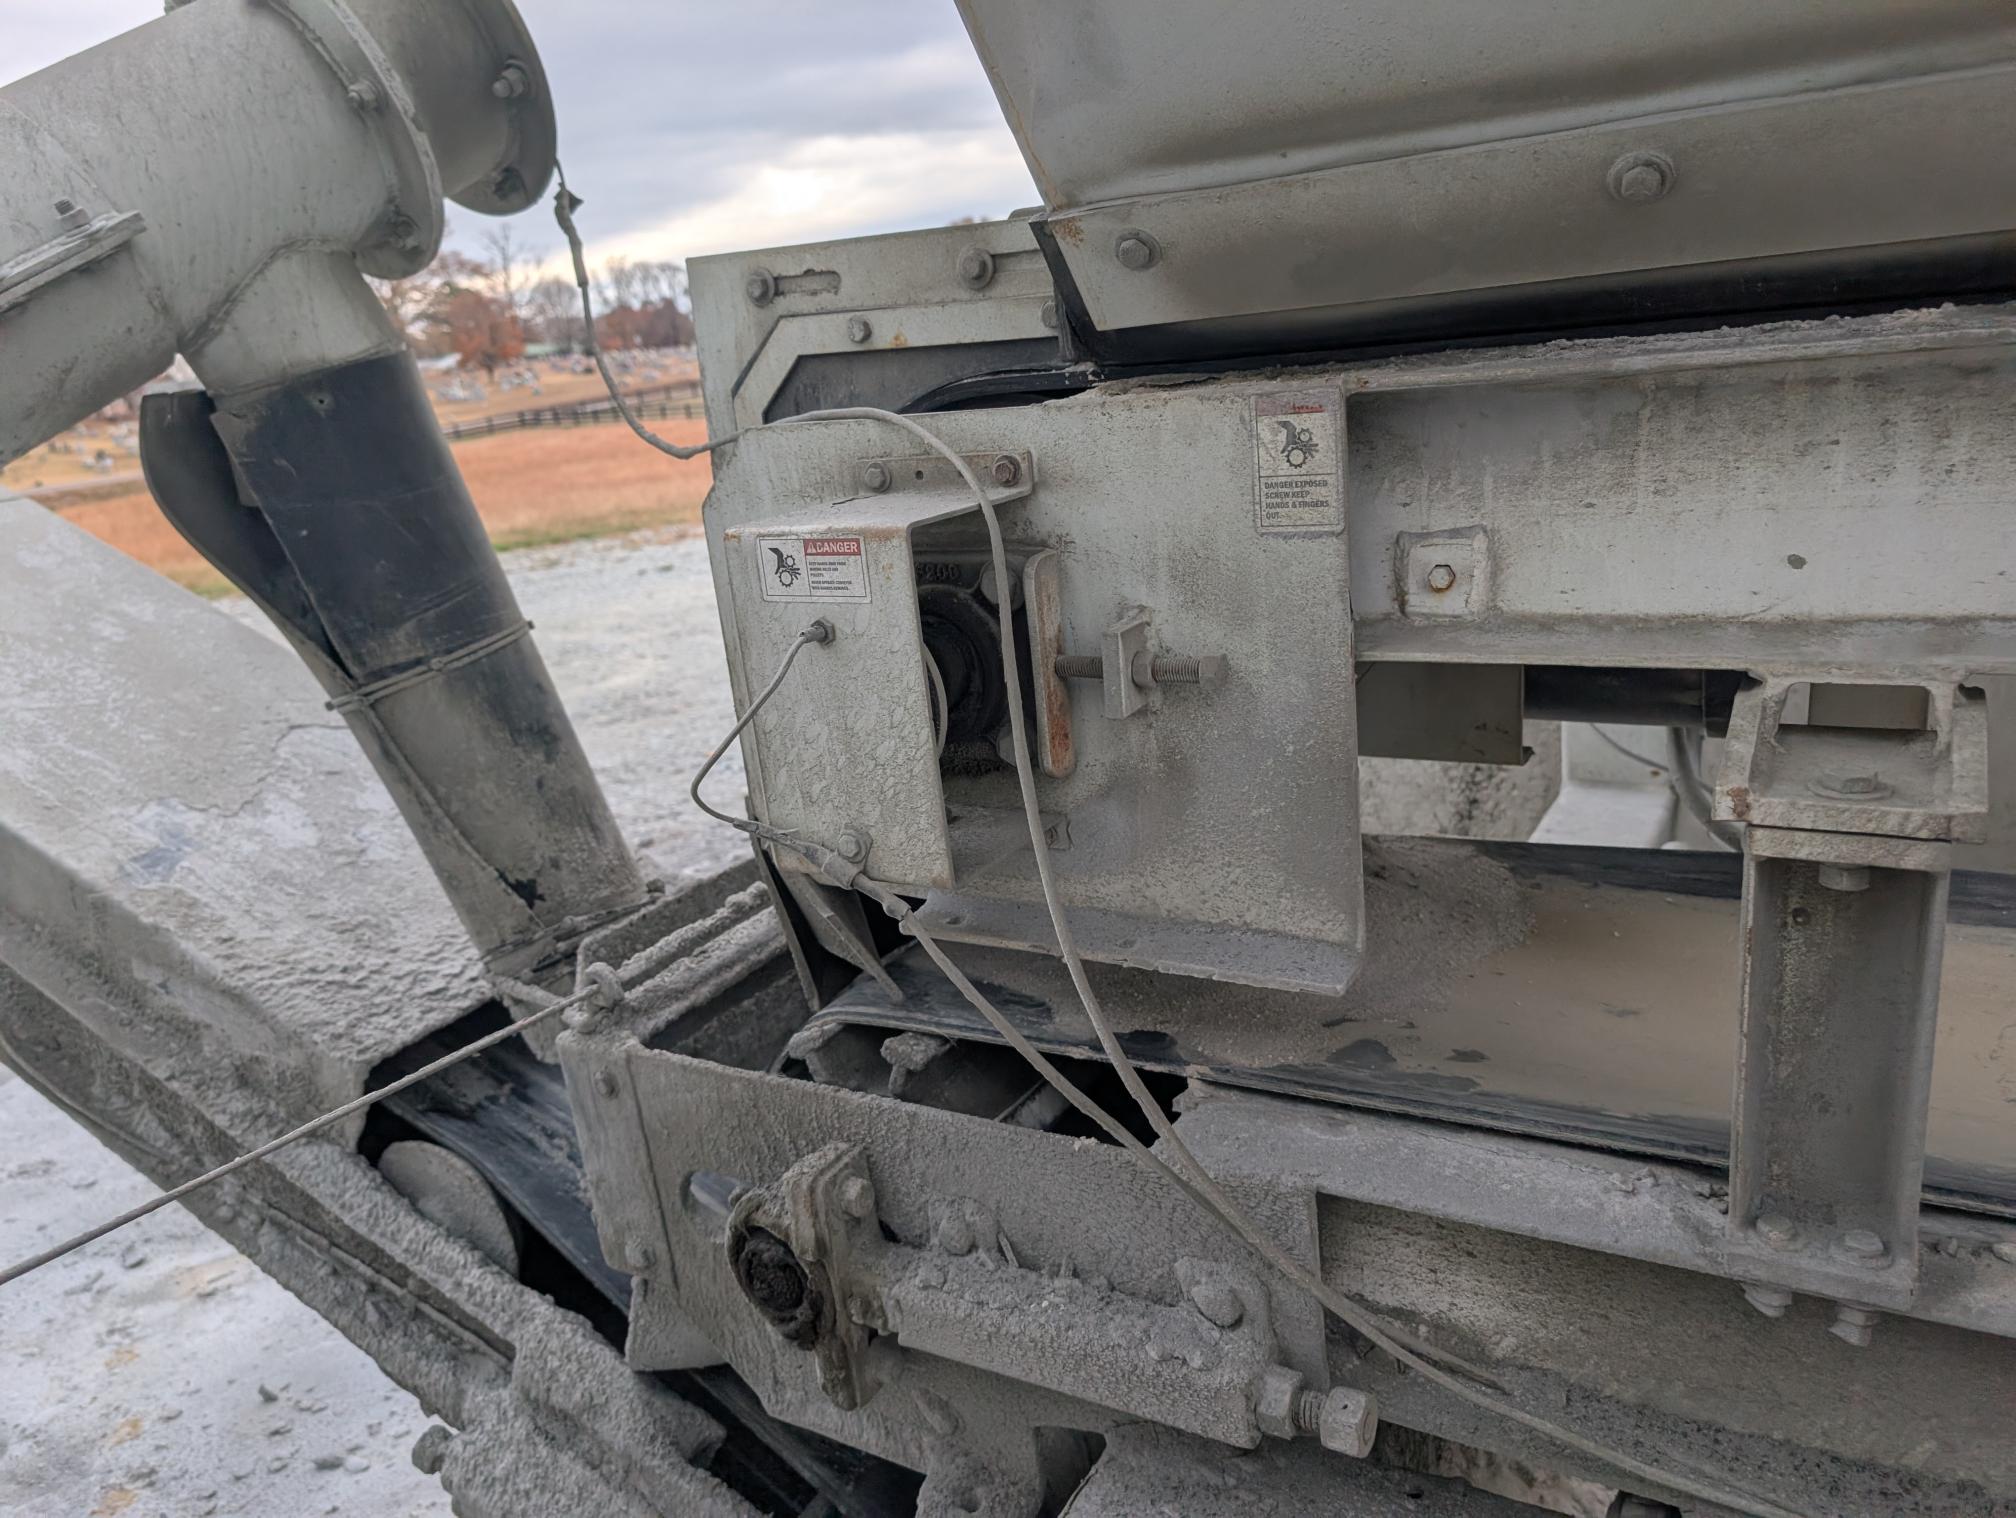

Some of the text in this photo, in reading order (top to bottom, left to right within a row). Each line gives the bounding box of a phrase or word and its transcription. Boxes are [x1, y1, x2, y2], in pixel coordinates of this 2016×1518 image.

[1264, 479, 1328, 490] DANGER EXPOSED
[1265, 490, 1310, 500] SCREW KEEP
[1265, 501, 1290, 510] HANDS
[1298, 500, 1329, 509] FINGERS
[816, 541, 858, 553] DANGER
